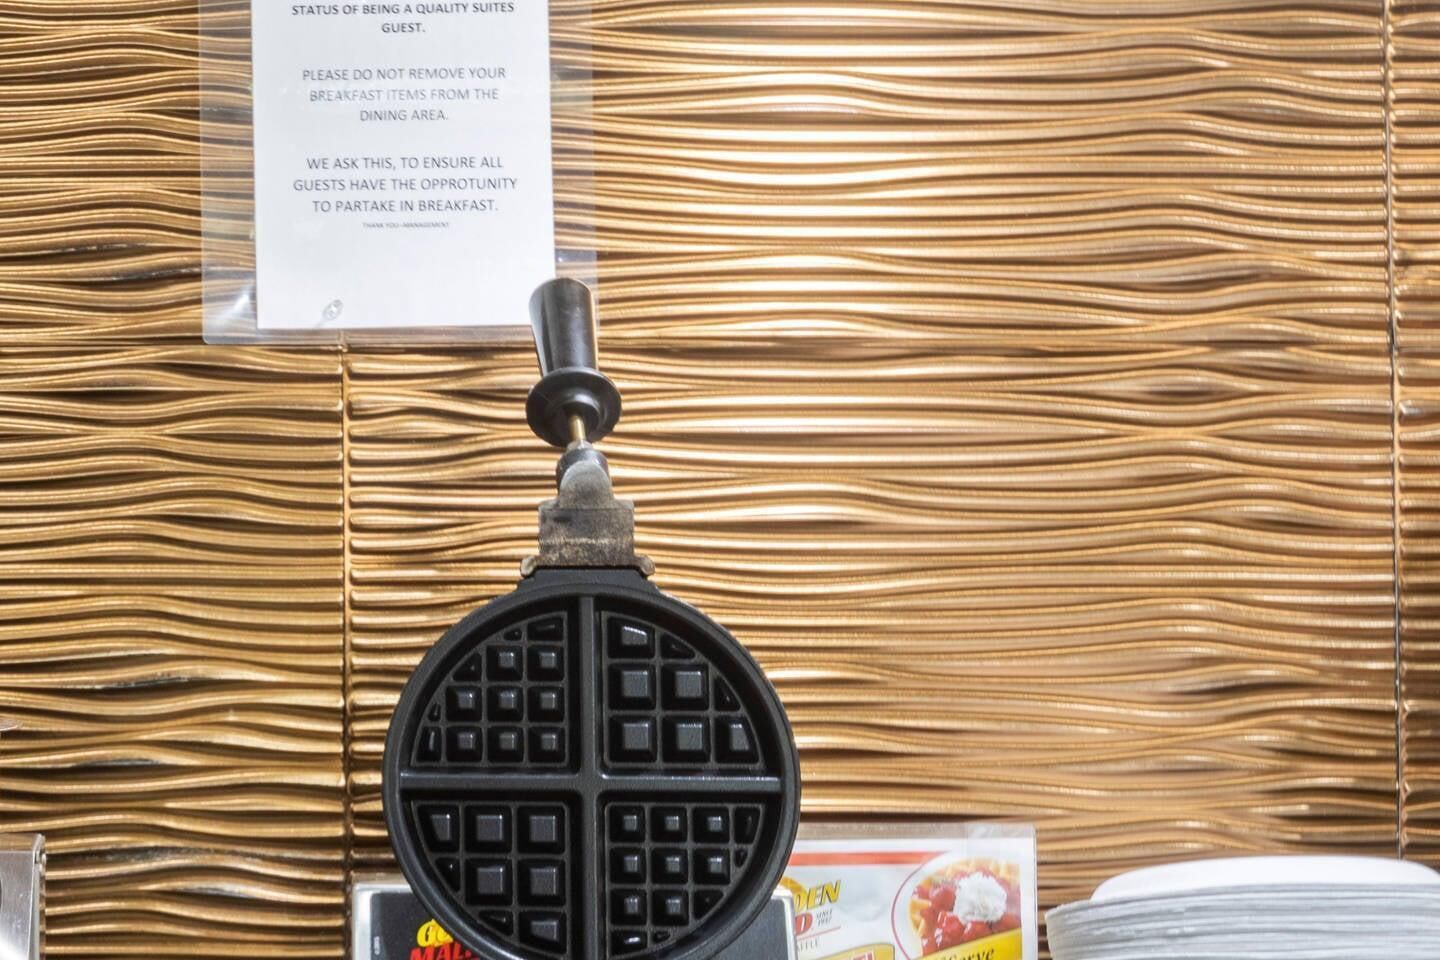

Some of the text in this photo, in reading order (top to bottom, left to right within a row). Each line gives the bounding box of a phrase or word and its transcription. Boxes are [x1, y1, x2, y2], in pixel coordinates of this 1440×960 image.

[292, 2, 515, 16] STATUS OF BEING A QUALITY SUITES
[381, 22, 426, 33] GUEST.
[303, 67, 506, 81] PLEASE DO NOT REMOVE YOUR
[310, 88, 499, 102] BREAKFAST ITEMS FROM THE
[360, 109, 449, 122] DINING AREA.
[307, 157, 504, 171] WE ASK THIS, TO ENSURE ALL
[293, 177, 517, 192] GUESTS HAVE THE OPPROTUNITY
[312, 199, 499, 213] TO PARTAKE IN BREAKFAST.
